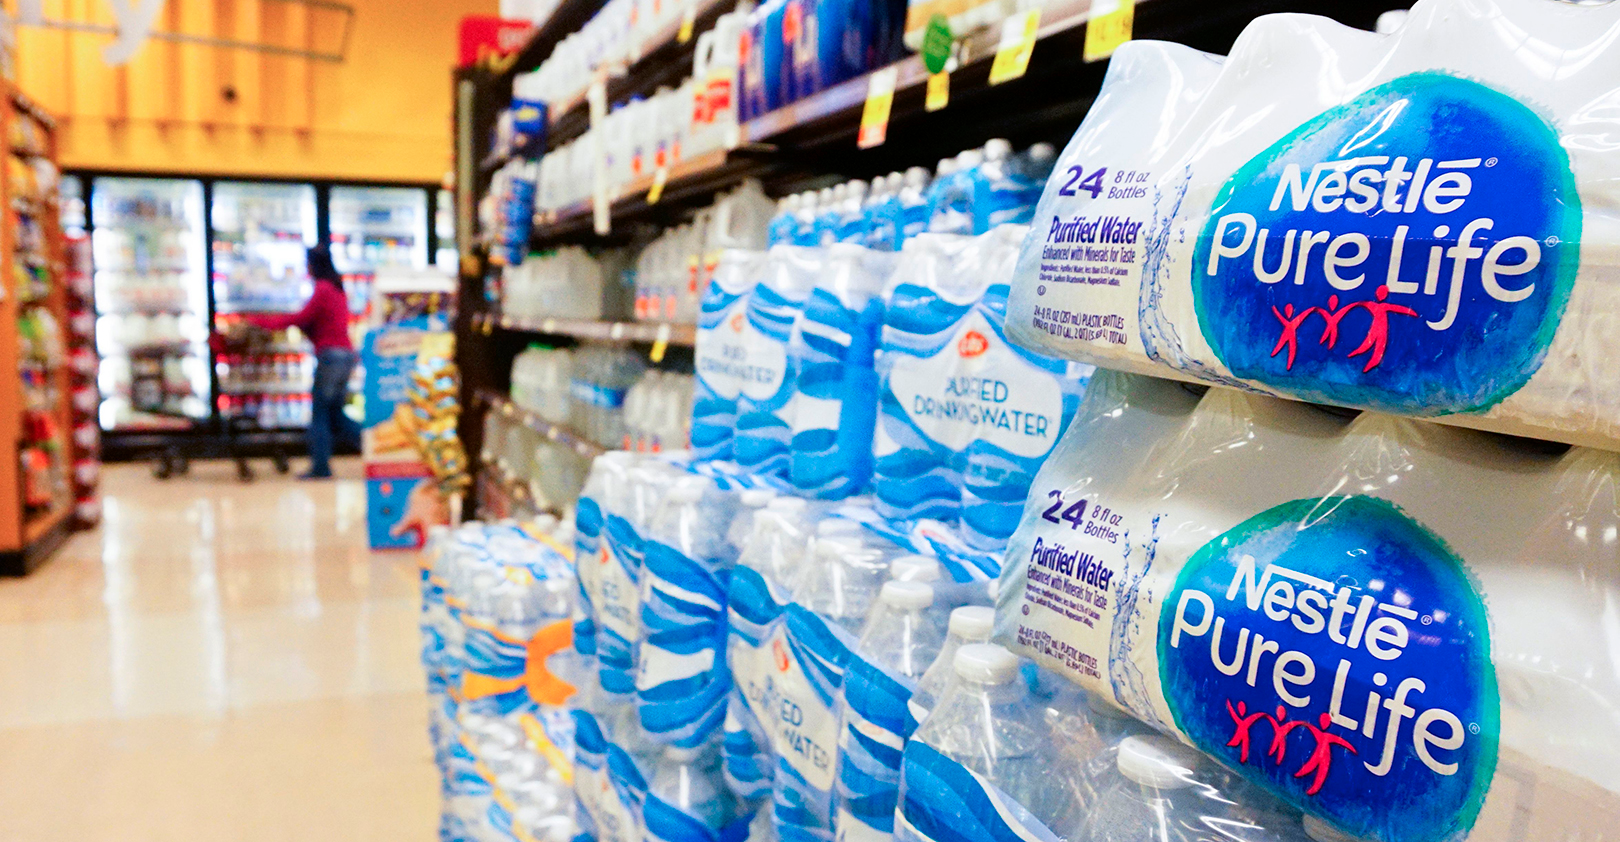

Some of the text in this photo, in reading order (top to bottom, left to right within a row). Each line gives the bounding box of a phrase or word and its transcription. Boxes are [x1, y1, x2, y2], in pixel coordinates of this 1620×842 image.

[1059, 165, 1108, 199] 24
[1114, 170, 1124, 183] 8
[1136, 172, 1150, 182] oz
[1107, 186, 1148, 199] Bottles
[1047, 215, 1143, 244] Purified Water
[1042, 245, 1135, 263] Enhanced with Minerals for Taste
[1207, 212, 1542, 331] Pure Life
[1046, 307, 1051, 320] FL
[1052, 310, 1059, 322] OZ
[1082, 313, 1102, 328] PLASTIC
[1103, 314, 1124, 329] BOTTLES
[980, 405, 1048, 438] WATER
[1042, 489, 1088, 530] 24
[1092, 505, 1101, 518] 8
[1109, 514, 1123, 526] oz
[1084, 520, 1119, 544] Bottles
[1030, 536, 1114, 592] Purified Water
[1028, 564, 1051, 586] Enhanced
[1063, 578, 1084, 600] Minerals
[1084, 587, 1093, 604] for
[1170, 589, 1465, 777] Pure Life
